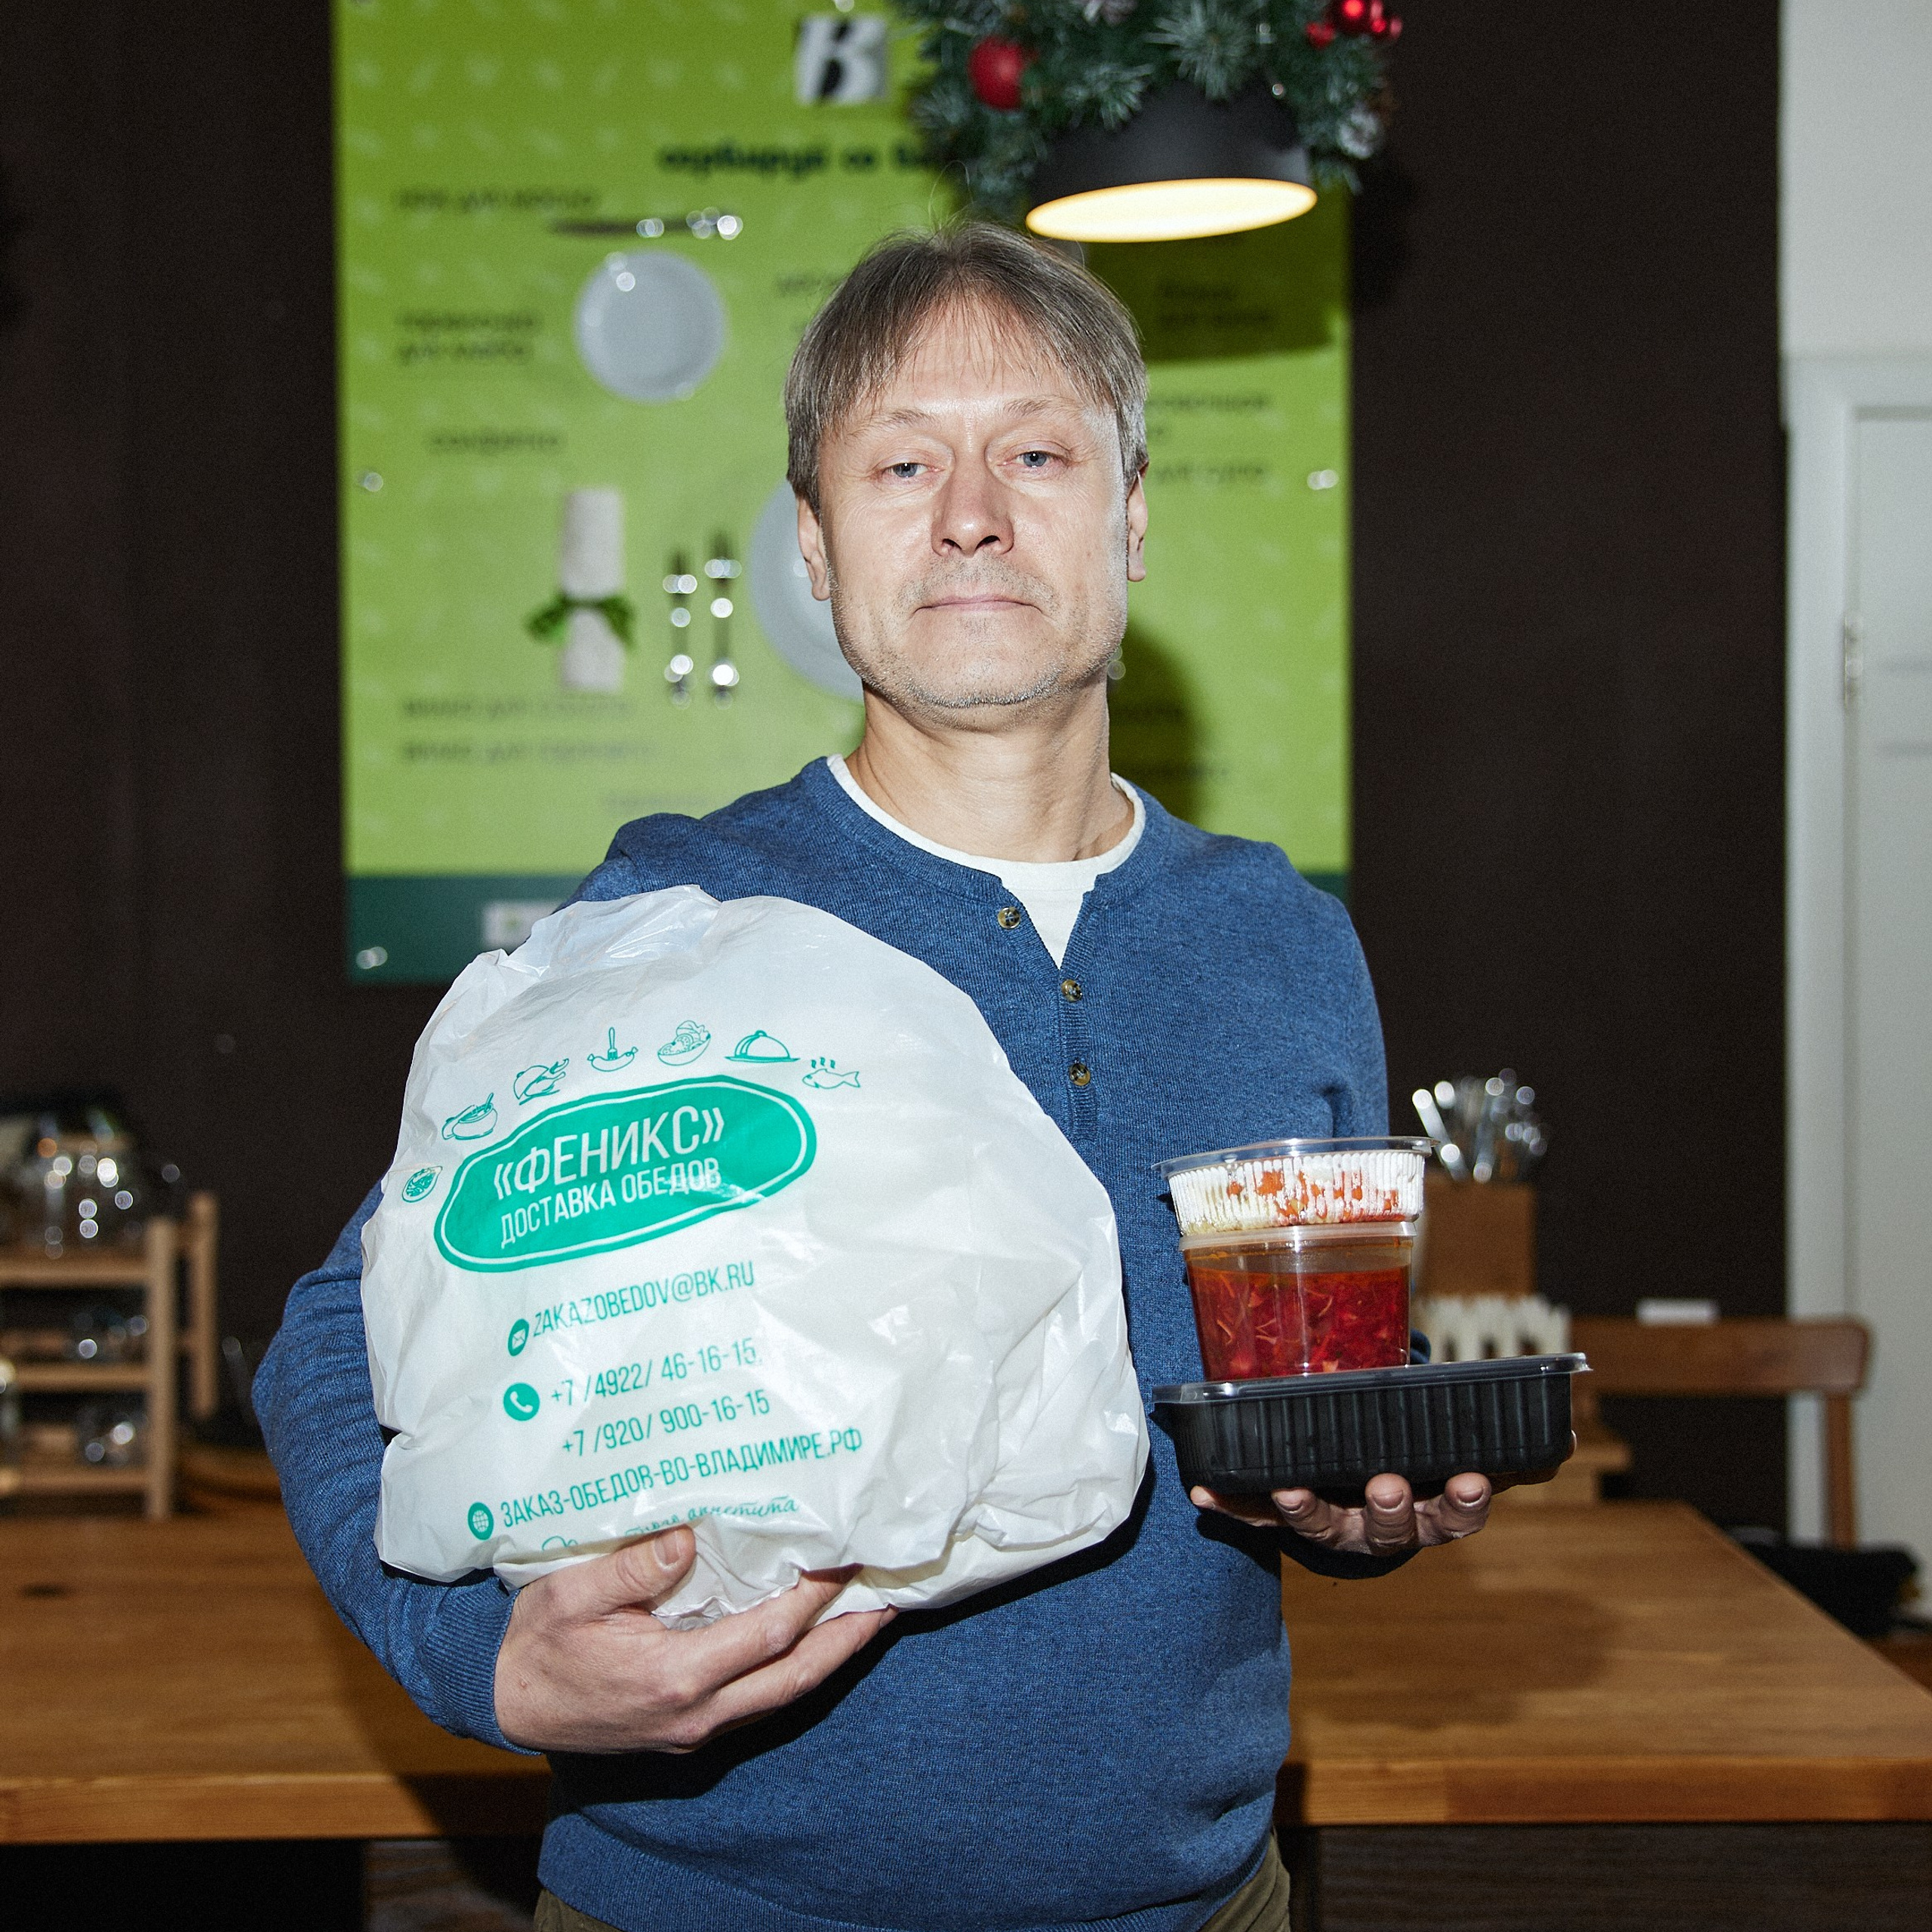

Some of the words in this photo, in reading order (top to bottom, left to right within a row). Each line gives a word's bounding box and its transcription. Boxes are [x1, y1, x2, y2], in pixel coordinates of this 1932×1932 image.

[494, 1105, 725, 1201] «ФЕНИКС»
[500, 1179, 617, 1249] ДОСТАВКА
[620, 1157, 722, 1203] ОБЕДОВ
[533, 1260, 755, 1337] ZAKAZOBEDOV@BK.RU
[552, 1378, 574, 1406] +7
[583, 1359, 653, 1403] /4922/
[562, 1429, 585, 1457] +7
[594, 1413, 653, 1453] /920/
[660, 1388, 771, 1434] 900-16-15
[500, 1427, 863, 1528] ЗАКАЗ-ОБЕДОВ-ВО-ВЛАДИМИРЕ.РФ
